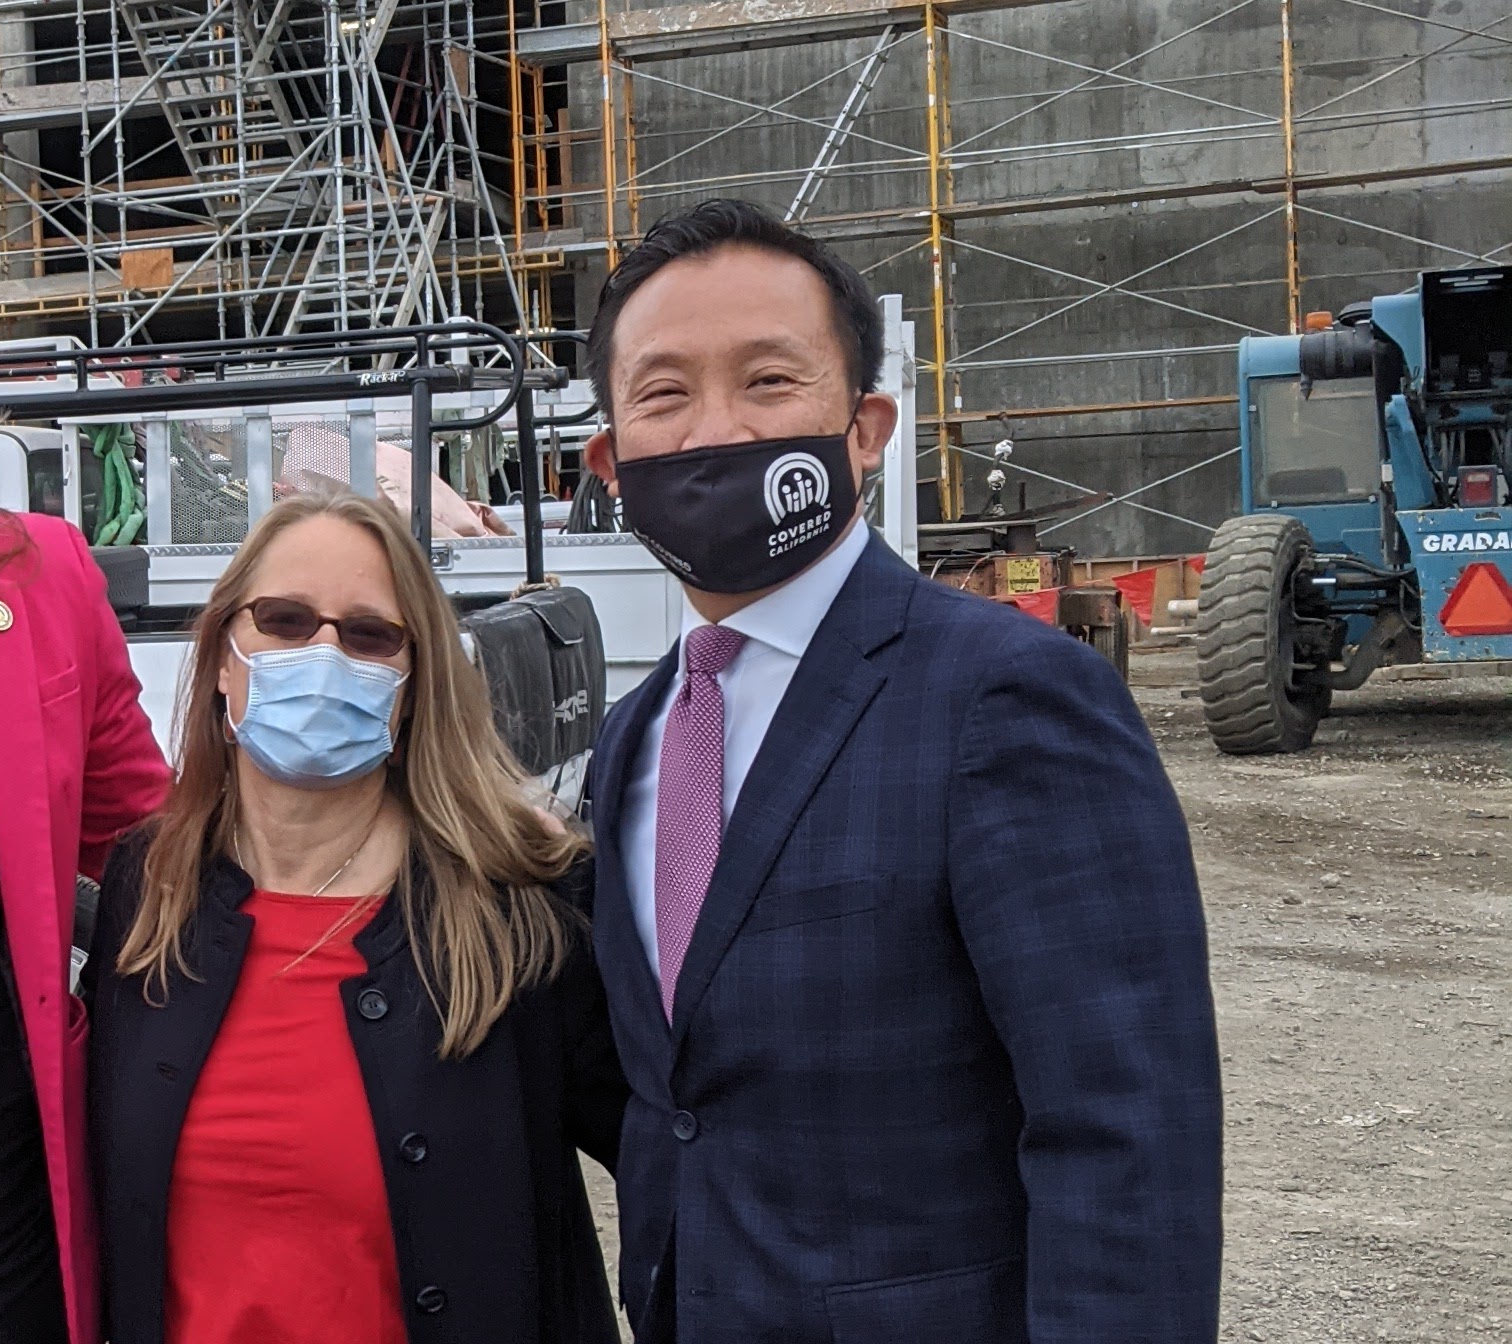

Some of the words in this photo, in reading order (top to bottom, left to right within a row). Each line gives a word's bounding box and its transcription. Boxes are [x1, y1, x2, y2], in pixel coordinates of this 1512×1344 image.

[768, 511, 831, 546] COVERED
[769, 523, 830, 558] CALIFORNIA
[1422, 532, 1512, 552] GRADA
